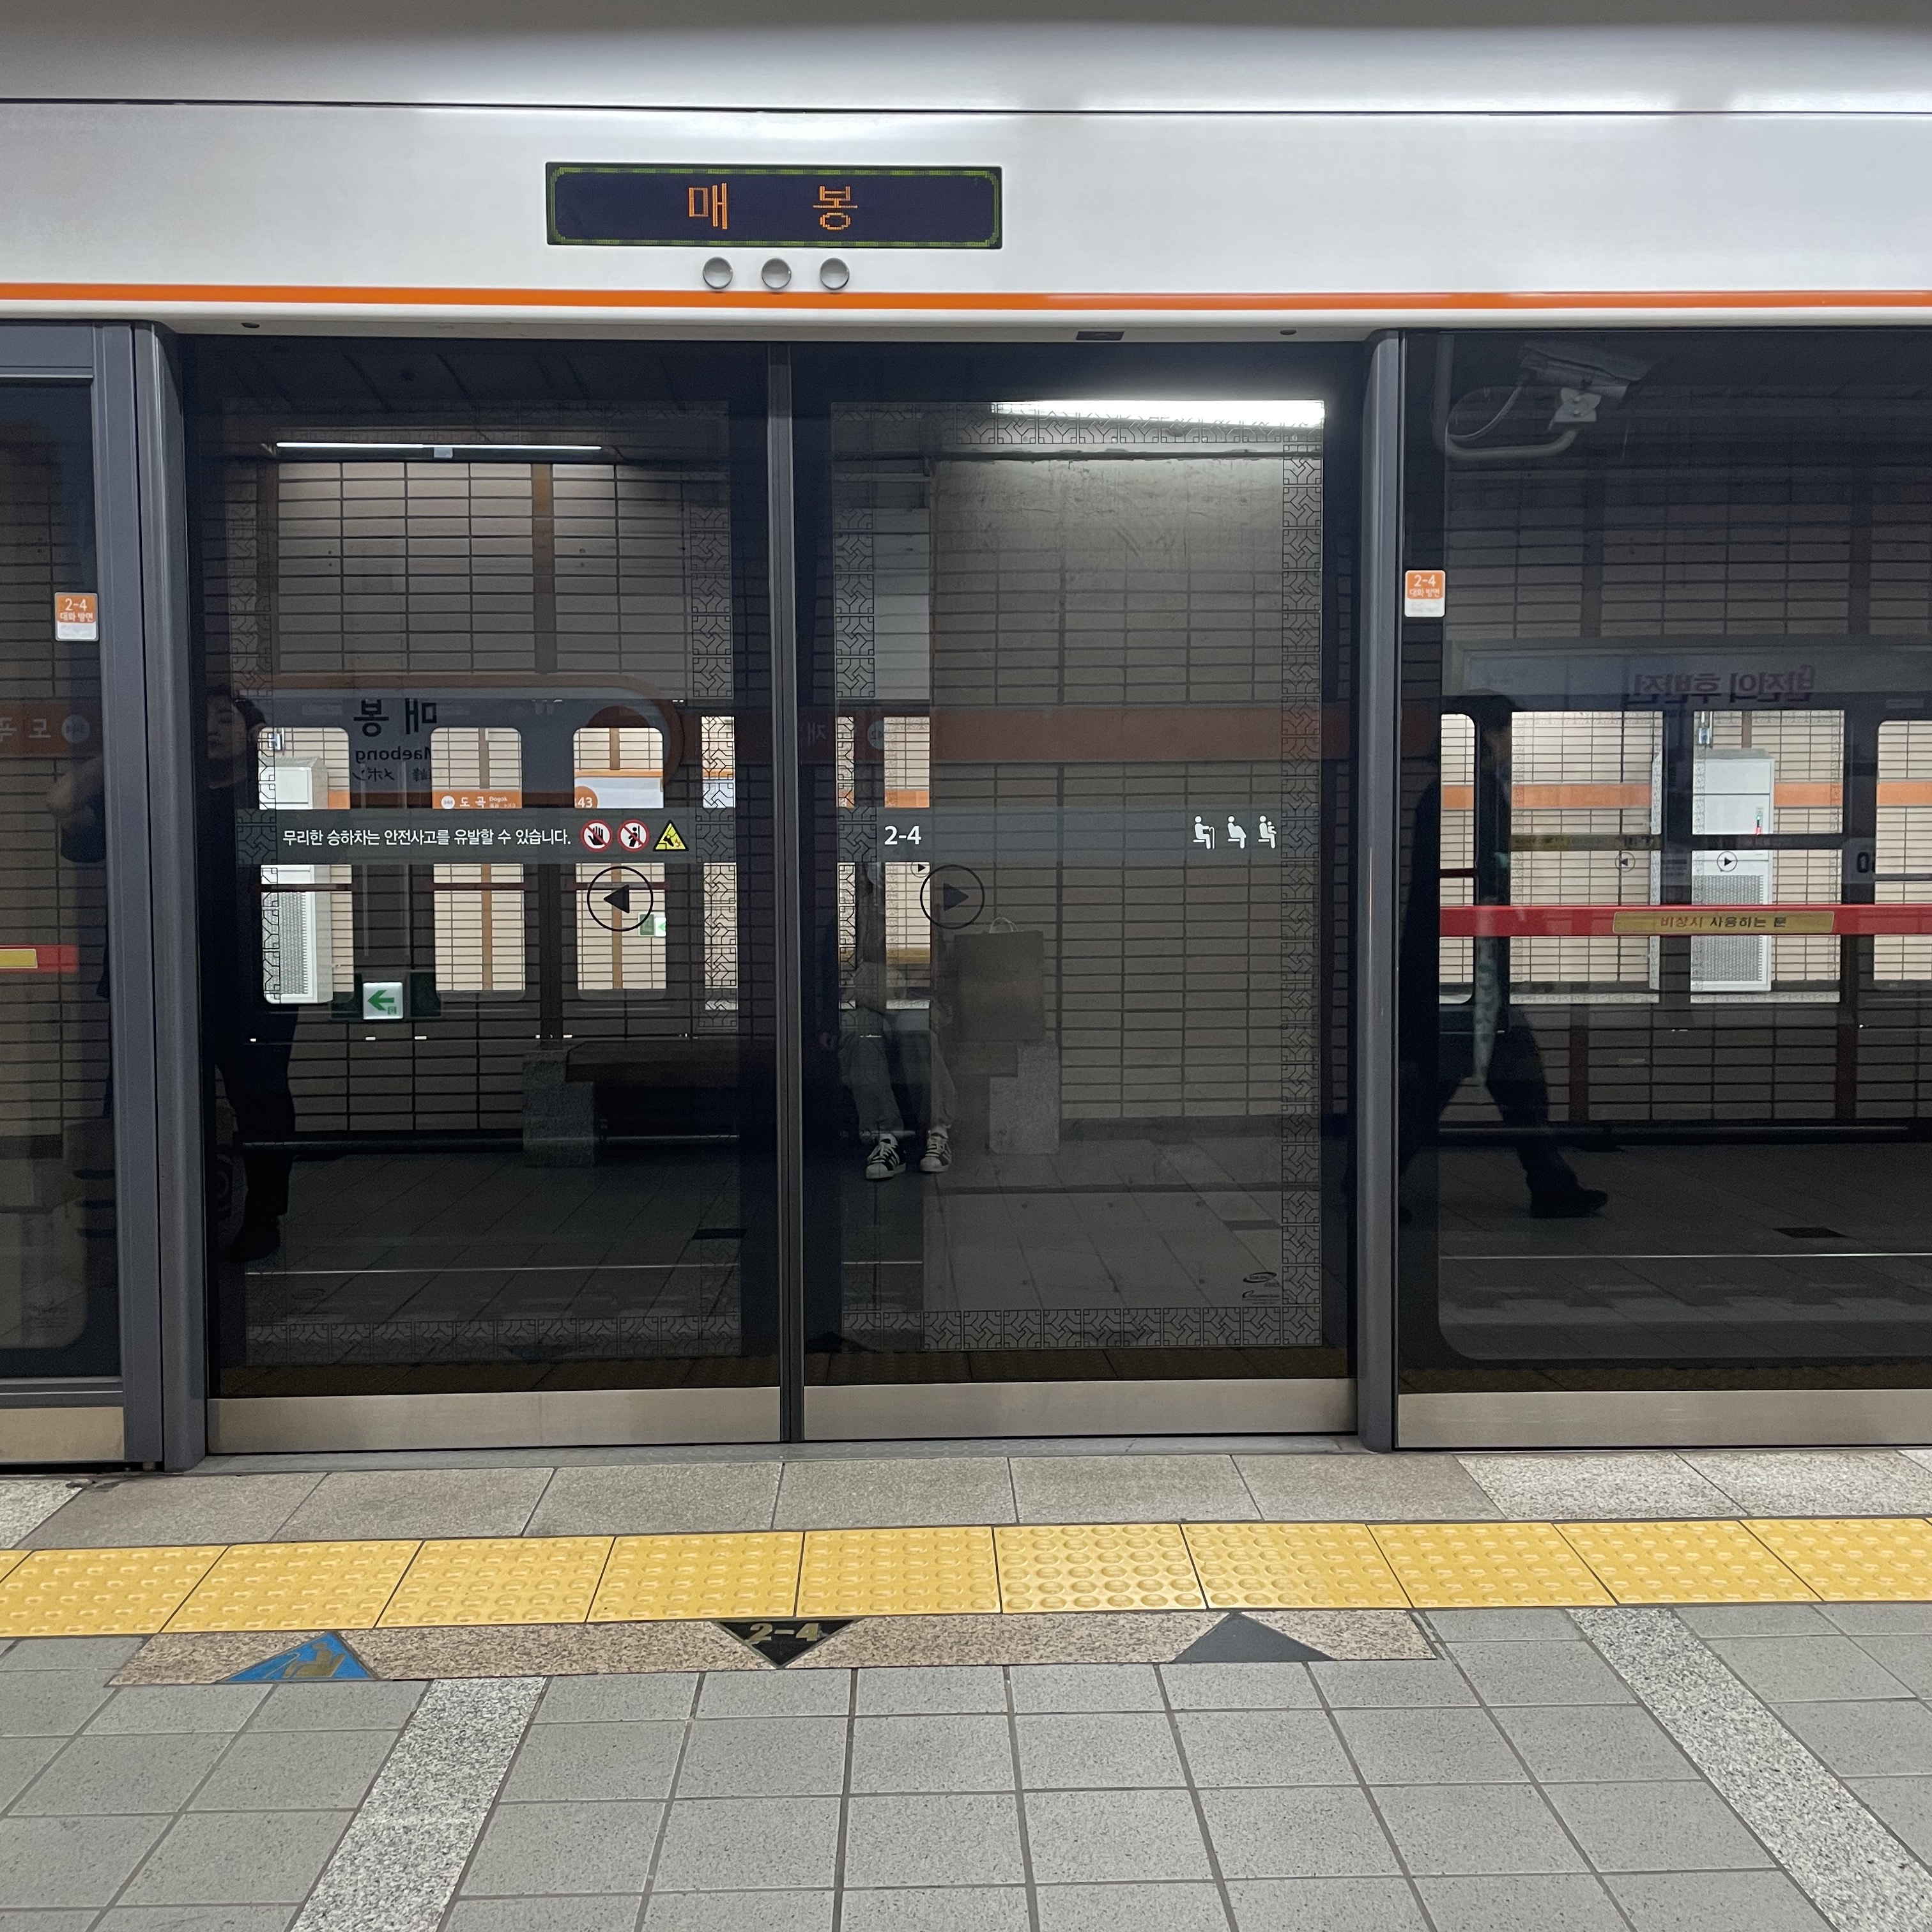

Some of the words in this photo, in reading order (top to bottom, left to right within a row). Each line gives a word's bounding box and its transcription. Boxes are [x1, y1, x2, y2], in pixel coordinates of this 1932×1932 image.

[1414, 574, 1436, 587] 2-4
[65, 597, 87, 611] 2-4
[575, 797, 594, 808] 43
[283, 829, 323, 846] 무리한
[327, 829, 380, 846] 승하차는
[384, 829, 450, 845] 안전사고를
[454, 829, 494, 845] 유발할
[498, 829, 512, 845] 수
[516, 829, 571, 845] 있습니다.
[884, 825, 922, 845] 2-4
[1661, 916, 1703, 928] 비상시
[1710, 916, 1766, 928] 사용하는
[745, 1623, 821, 1644] 2-4
